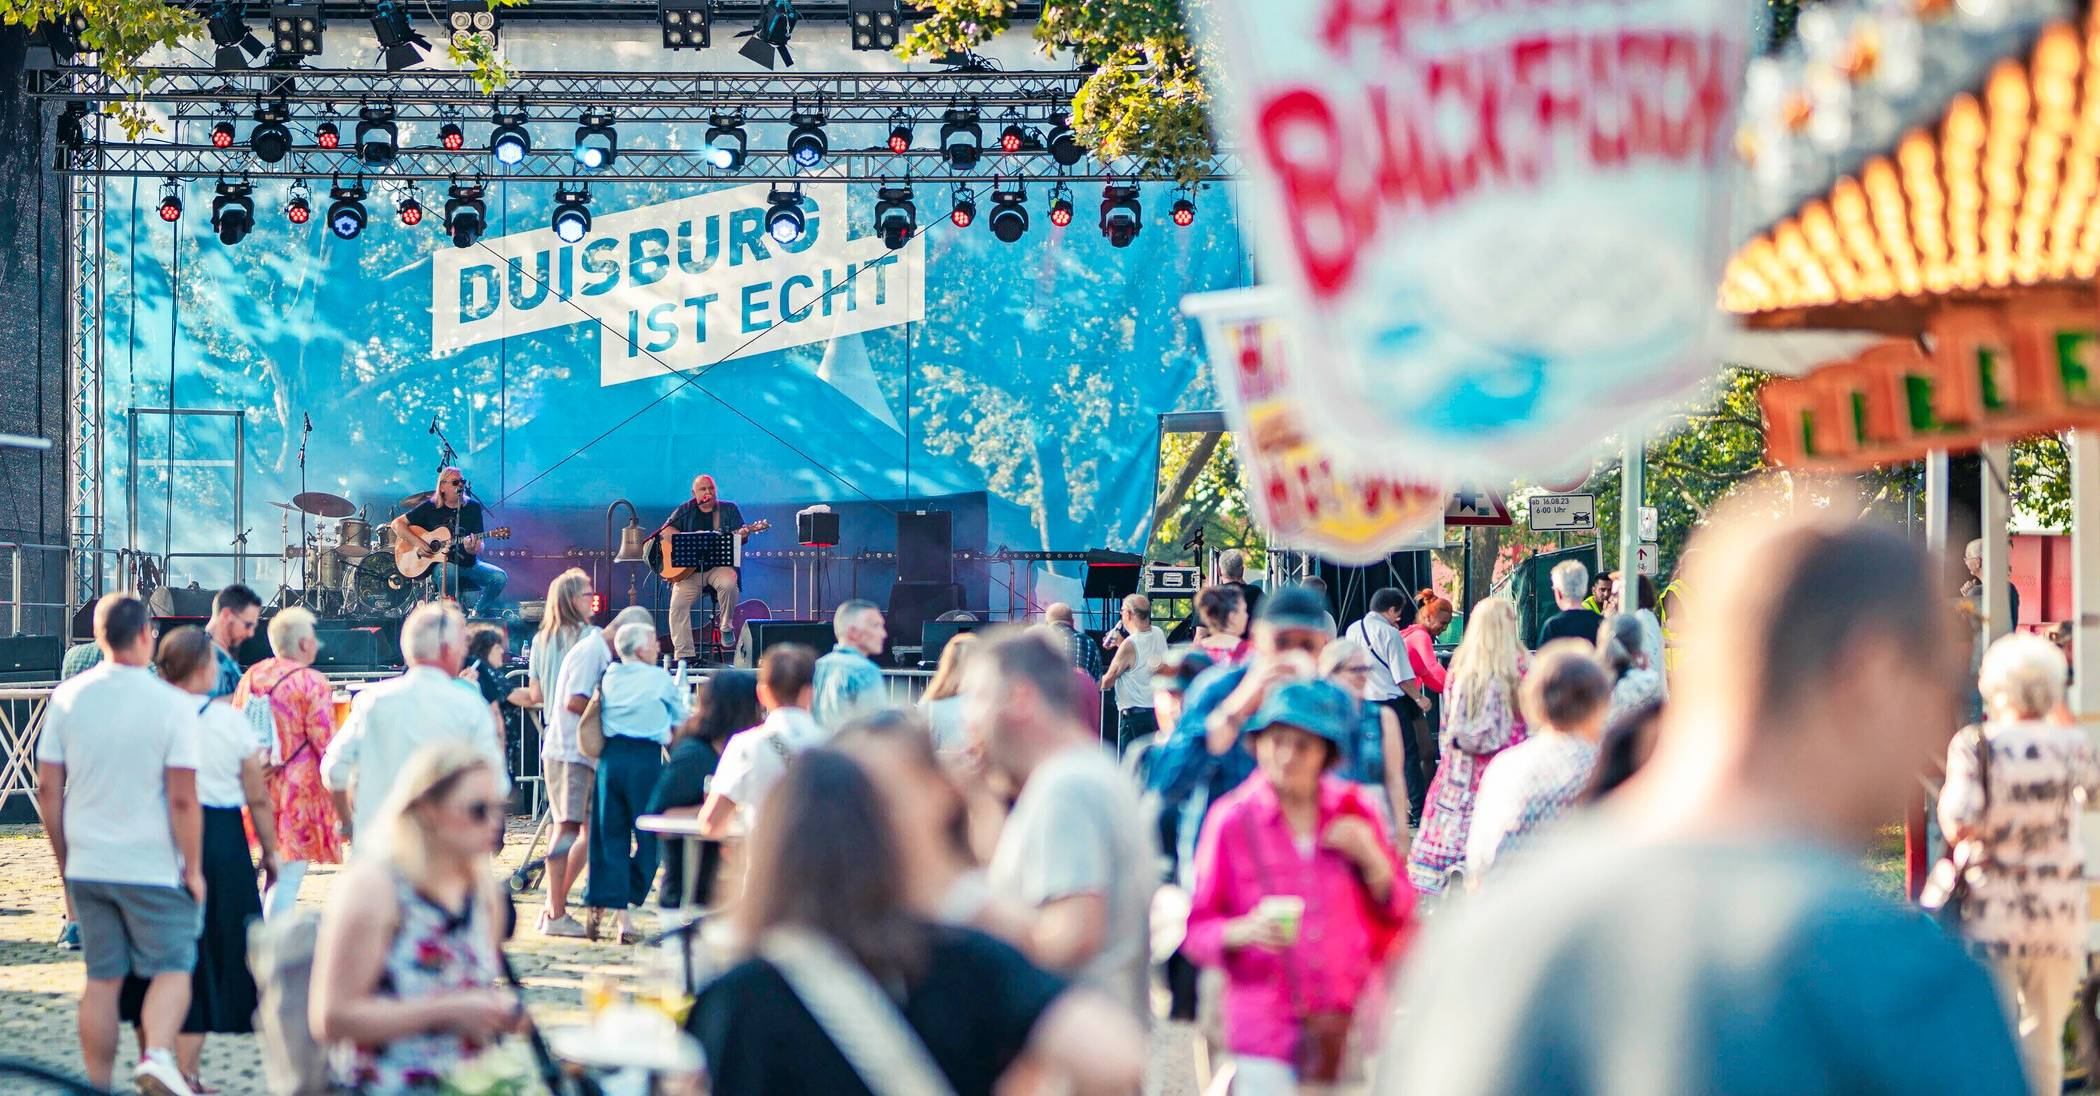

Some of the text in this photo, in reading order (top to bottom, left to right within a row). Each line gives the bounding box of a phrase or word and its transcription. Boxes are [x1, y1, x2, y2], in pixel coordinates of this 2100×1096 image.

[458, 195, 820, 324] DUISBURG
[627, 254, 898, 358] IST ECHT
